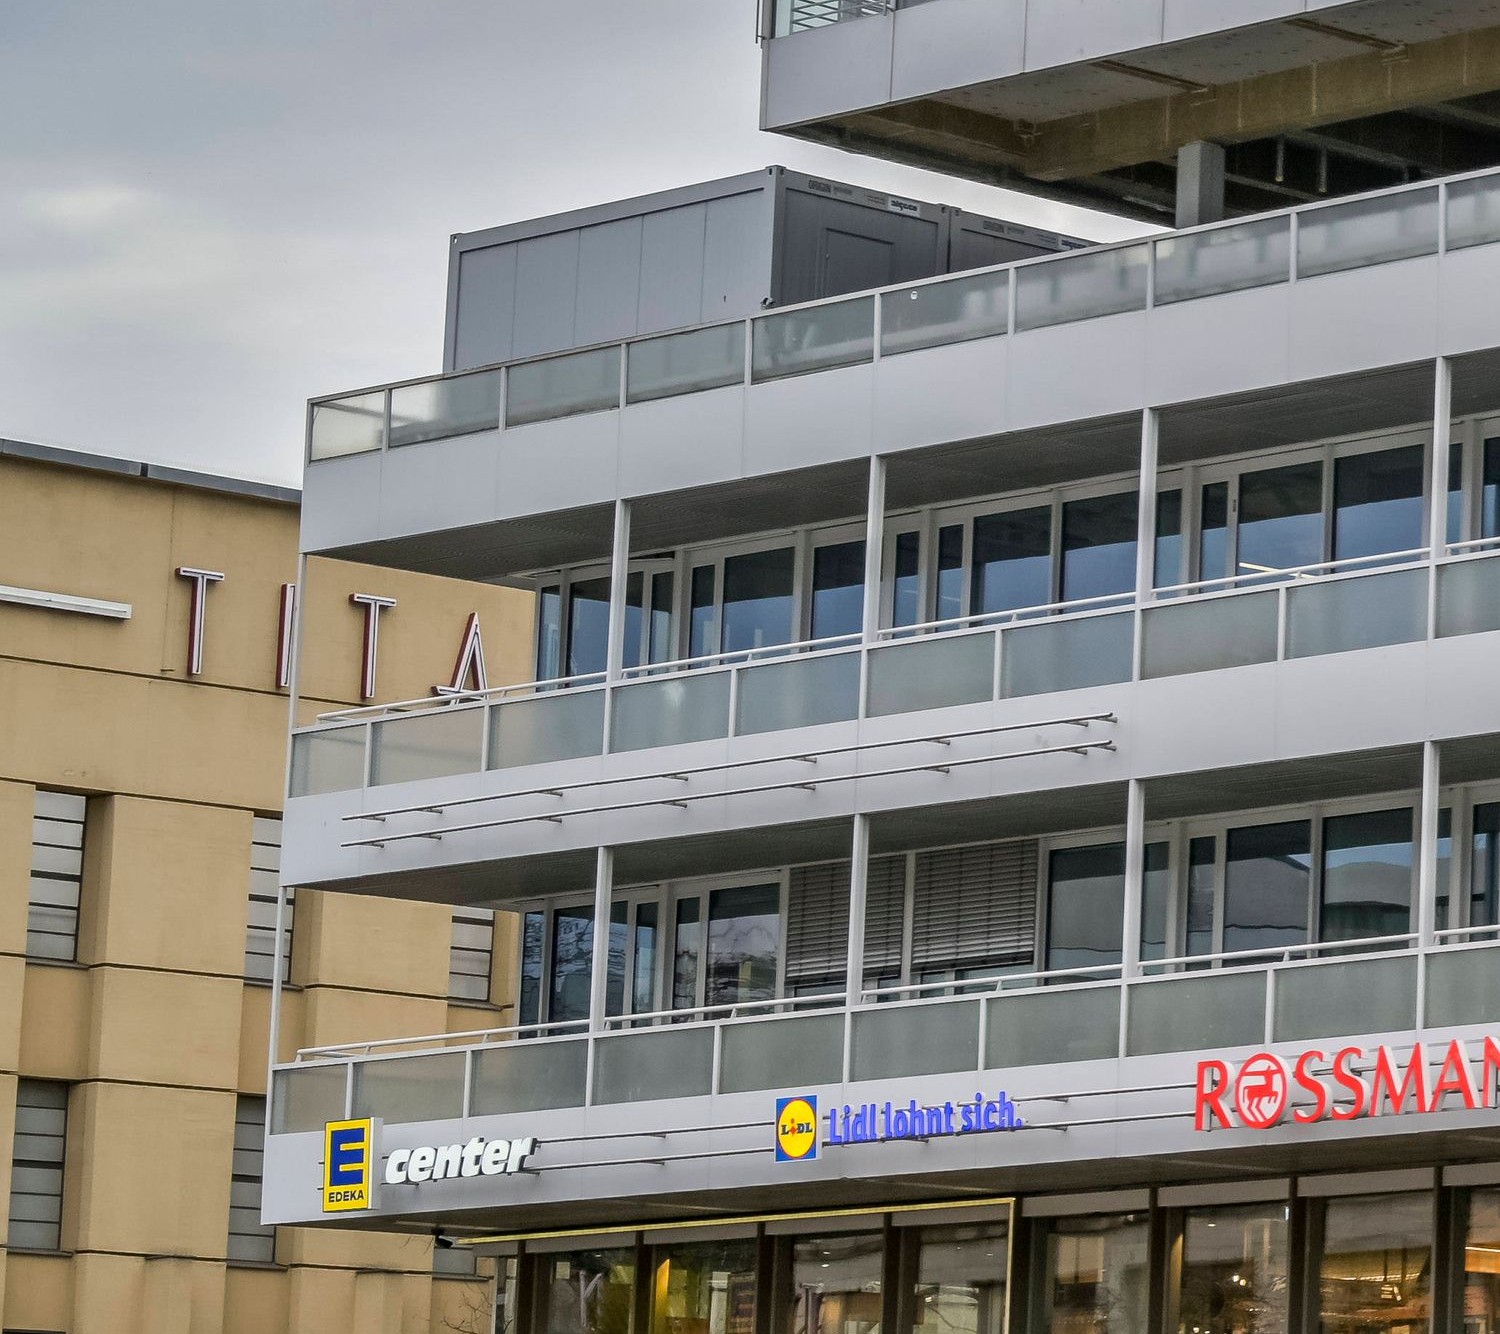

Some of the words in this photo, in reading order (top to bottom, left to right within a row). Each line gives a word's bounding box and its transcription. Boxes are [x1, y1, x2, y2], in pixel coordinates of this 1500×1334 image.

[175, 566, 489, 705] TITA
[780, 1118, 814, 1137] LIDL
[828, 1103, 877, 1144] Lidl
[884, 1101, 955, 1142] lohnt
[960, 1091, 1023, 1133] sich.
[385, 1136, 535, 1185] center
[328, 1189, 365, 1204] EDEKA
